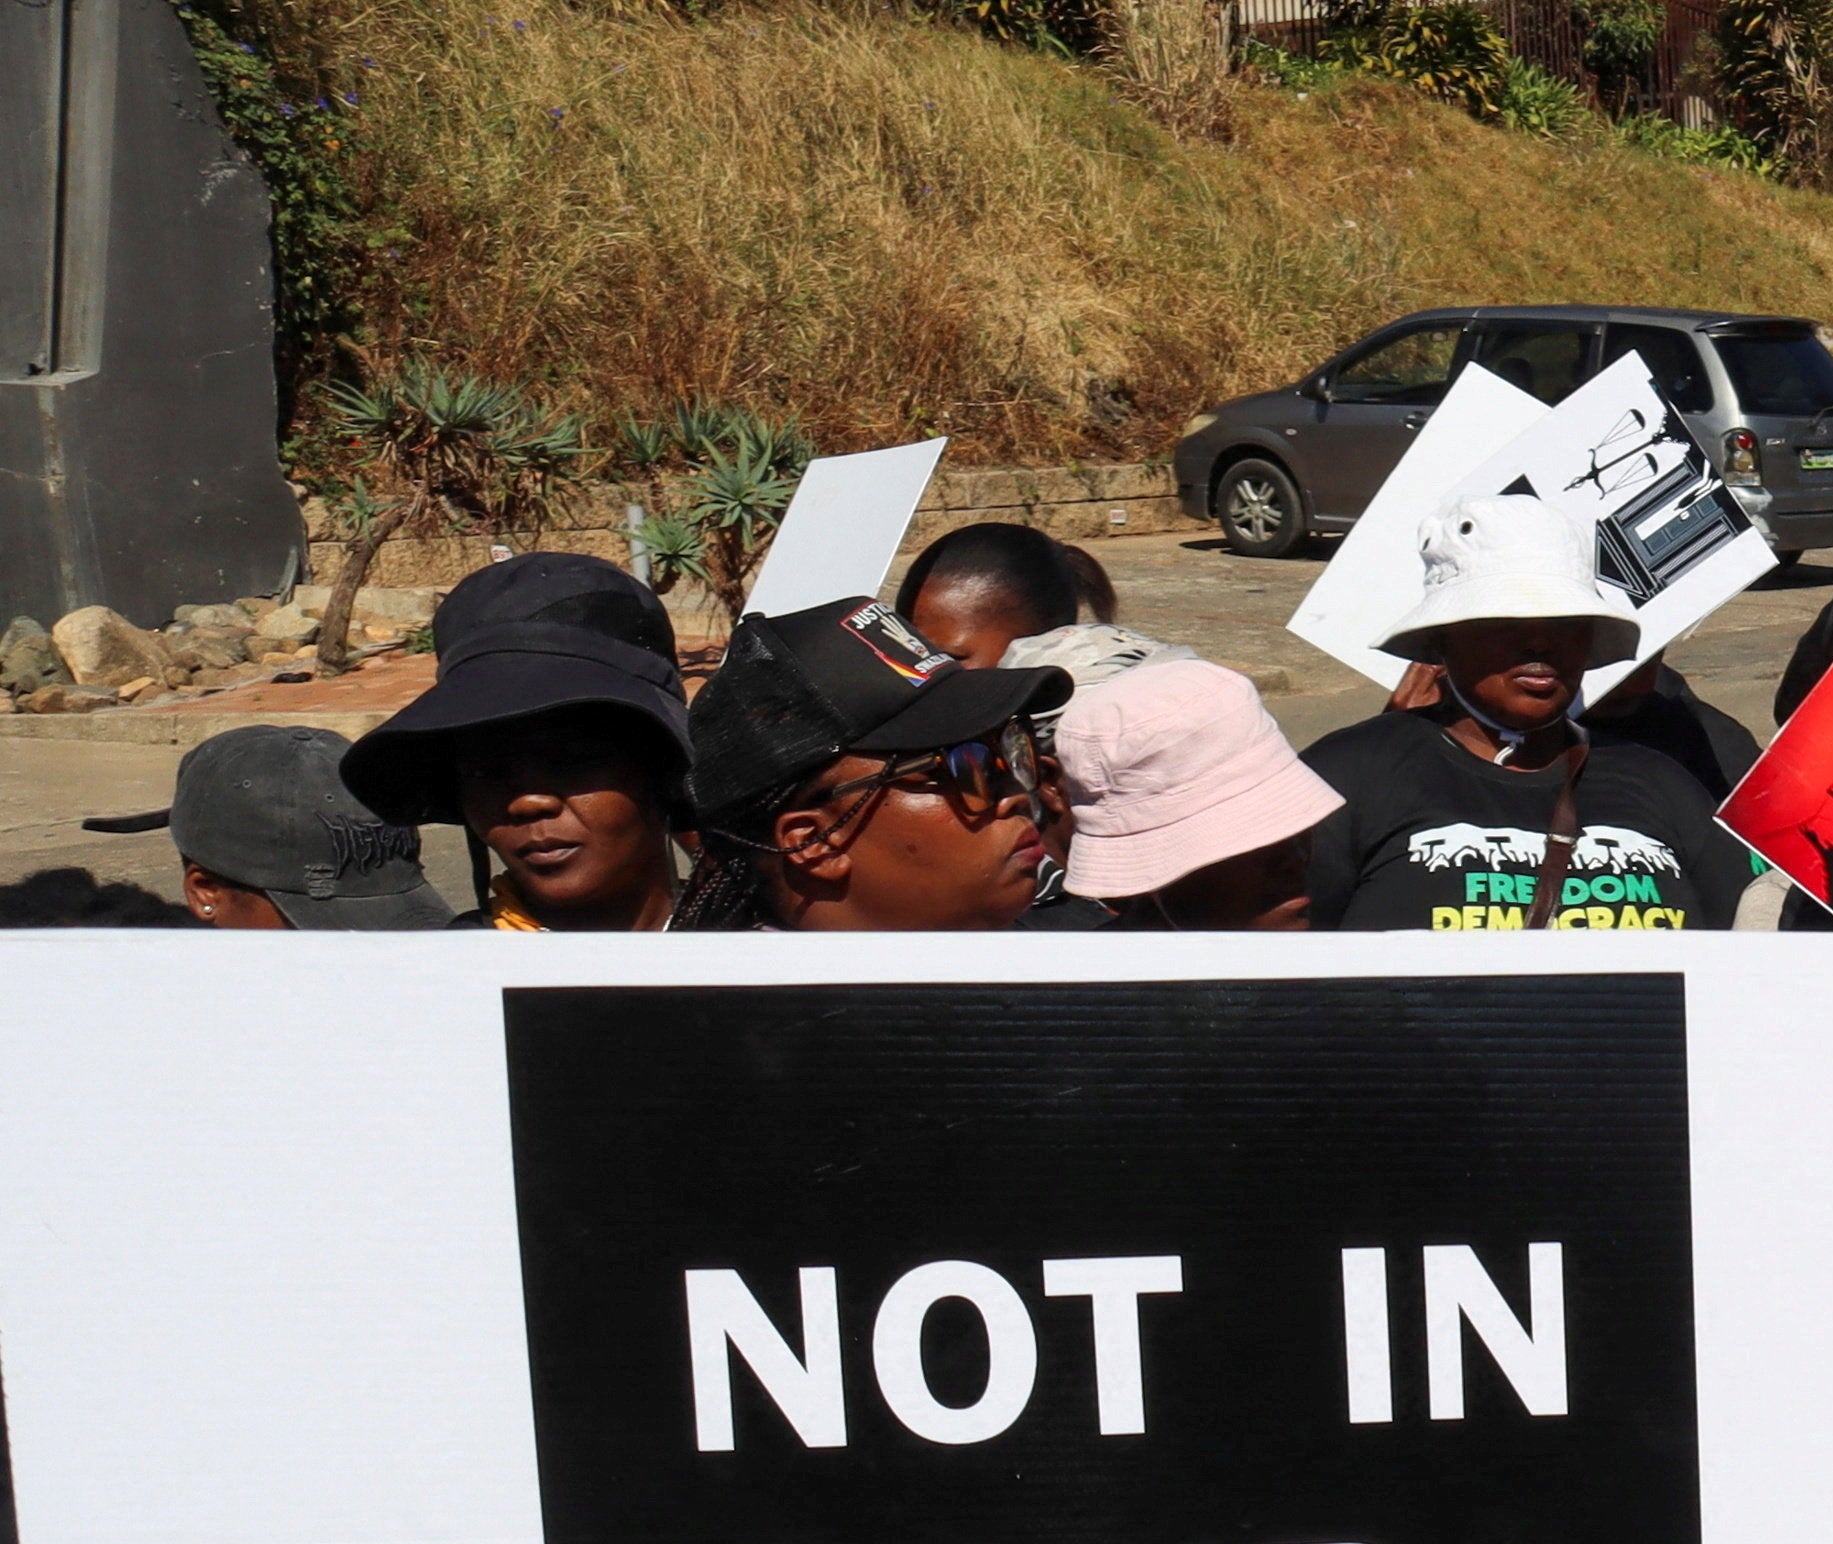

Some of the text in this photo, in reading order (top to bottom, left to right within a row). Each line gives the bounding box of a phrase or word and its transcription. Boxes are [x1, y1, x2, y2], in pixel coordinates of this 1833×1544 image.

[1465, 872, 1661, 905] FREDOM
[1432, 905, 1686, 929] DEMCRACY
[685, 1242, 1568, 1452] NOT IN
